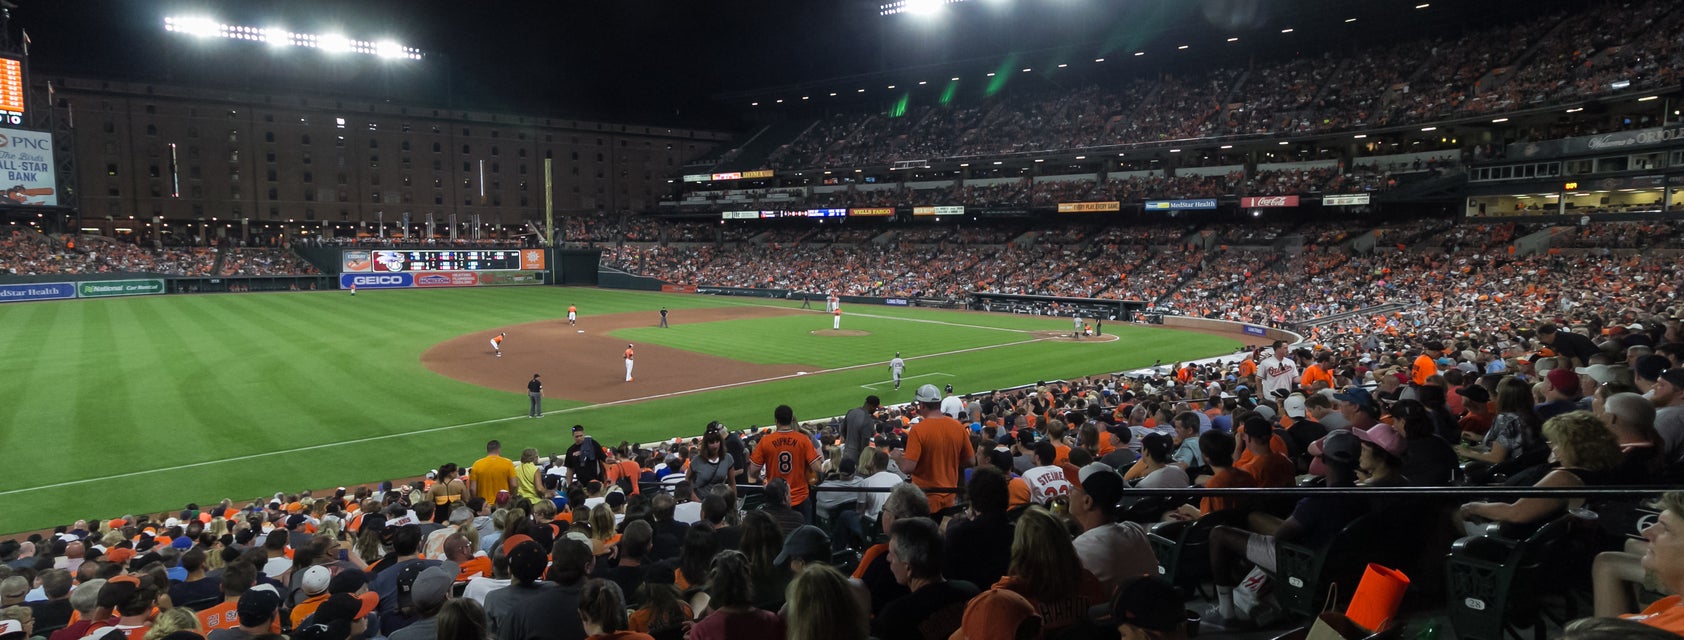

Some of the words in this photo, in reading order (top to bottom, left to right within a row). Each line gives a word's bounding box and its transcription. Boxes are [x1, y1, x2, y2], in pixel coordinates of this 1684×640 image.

[11, 136, 49, 151] PNC
[18, 152, 44, 162] Birds
[8, 170, 38, 182] BANK
[1170, 201, 1194, 209] MedStar
[1194, 200, 1216, 208] Health
[353, 275, 403, 285] GEICO
[28, 287, 60, 296] Health
[93, 284, 123, 292] National
[771, 437, 798, 448] RIPKEN
[778, 450, 793, 475] 8
